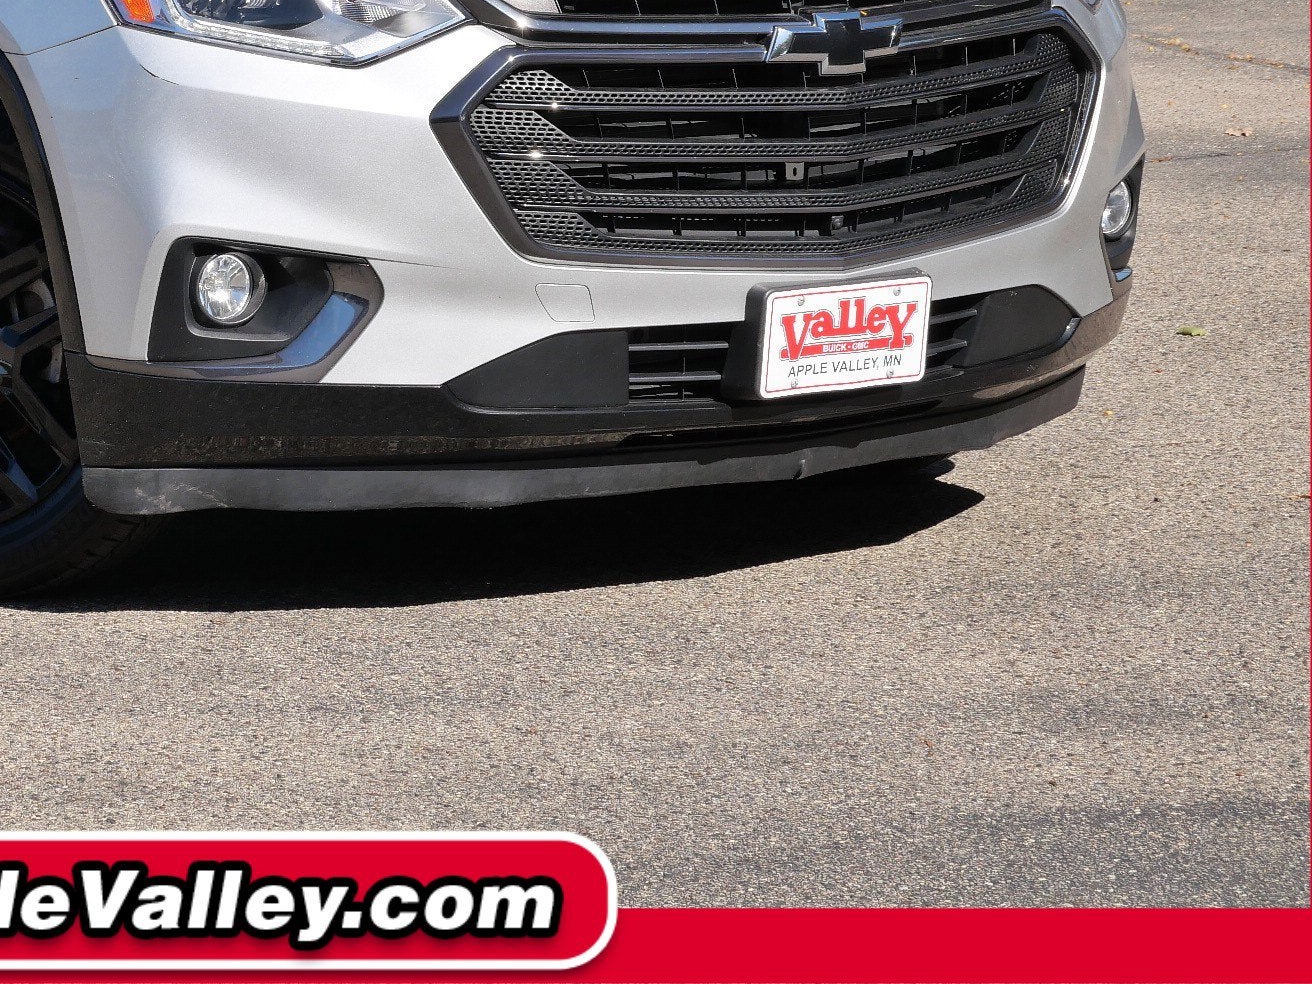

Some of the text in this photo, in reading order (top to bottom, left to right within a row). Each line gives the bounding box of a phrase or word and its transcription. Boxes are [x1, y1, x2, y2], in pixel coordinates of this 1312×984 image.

[781, 298, 918, 361] Valley
[822, 340, 869, 353] BUICK GMC
[788, 362, 828, 378] APPLE
[883, 354, 902, 367] MN
